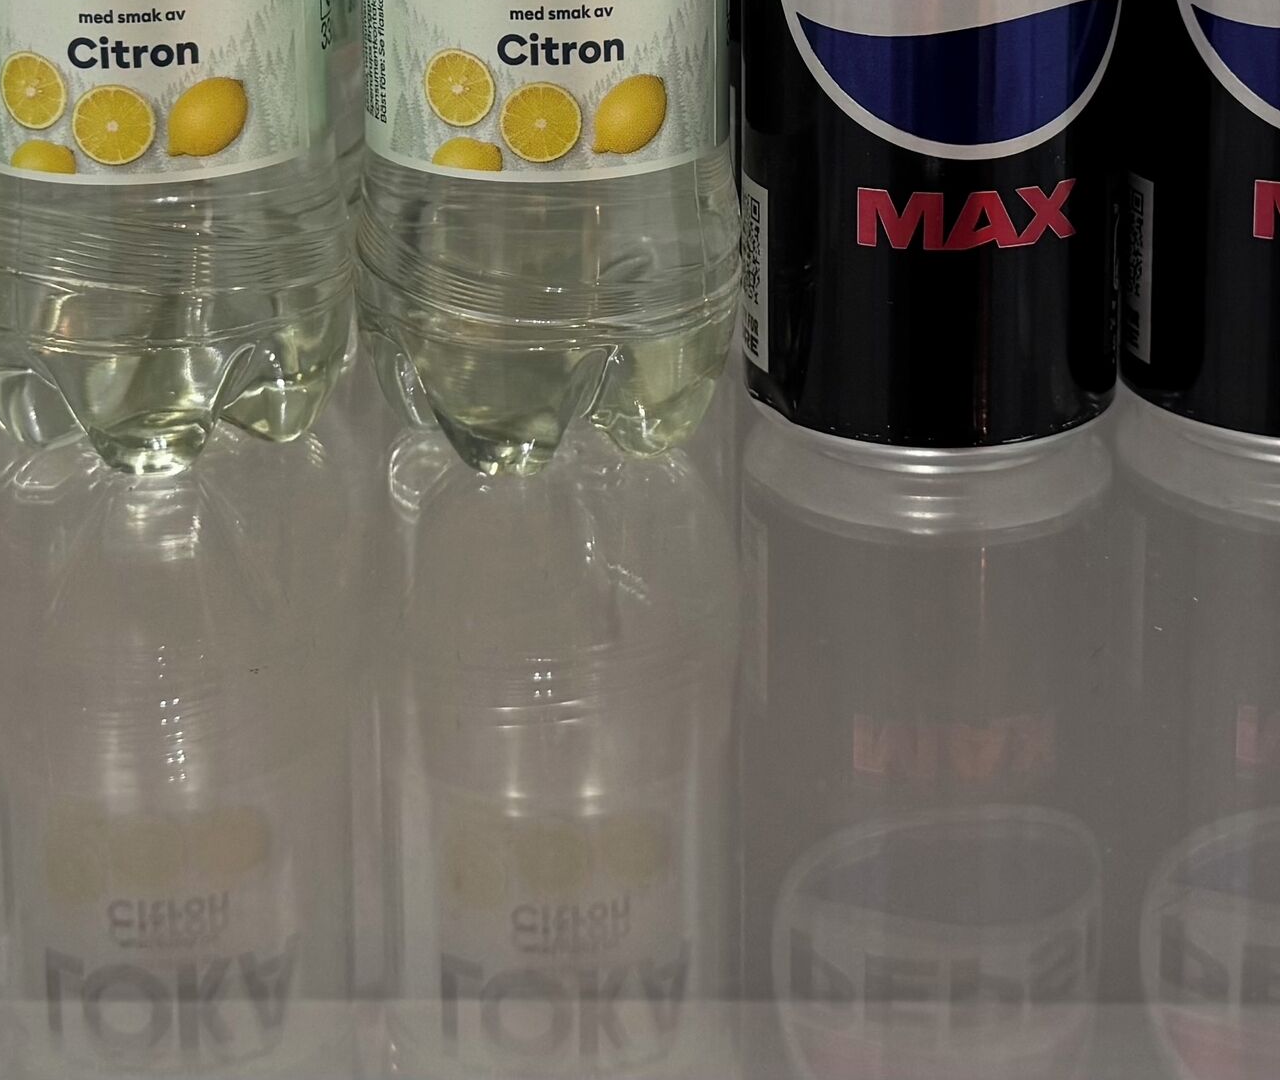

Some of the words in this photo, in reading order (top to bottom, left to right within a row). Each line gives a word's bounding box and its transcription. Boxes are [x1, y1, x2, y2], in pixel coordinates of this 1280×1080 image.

[78, 10, 115, 25] med
[117, 8, 163, 24] smak
[165, 8, 186, 22] av
[509, 6, 544, 21] med
[548, 5, 592, 20] smak
[593, 6, 614, 19] av
[67, 36, 199, 70] Citron
[497, 33, 625, 67] Citron
[856, 177, 1077, 251] MAX
